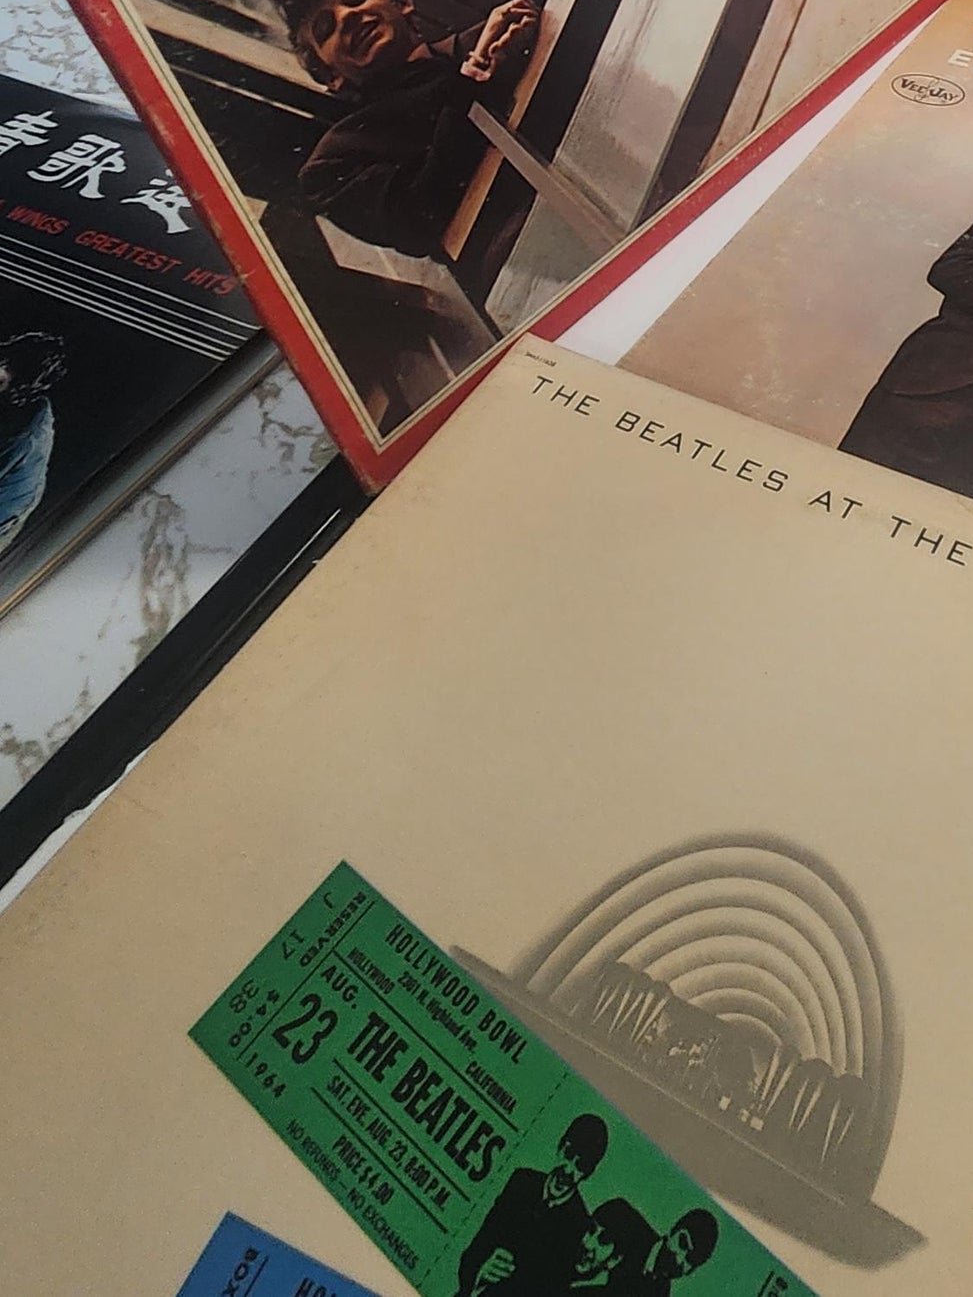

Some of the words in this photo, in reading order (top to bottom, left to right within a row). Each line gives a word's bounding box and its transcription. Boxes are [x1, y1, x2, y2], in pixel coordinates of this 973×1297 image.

[7, 205, 70, 235] WINGS
[75, 229, 183, 274] GREATEST
[183, 267, 240, 296] HITS
[530, 375, 600, 417] THE
[614, 410, 789, 493] BEATLES
[808, 489, 863, 520] AT
[890, 515, 973, 567] THE
[300, 891, 366, 968] RESERVED
[321, 965, 360, 1009] AUG.
[385, 924, 480, 1017] HOLLYWOOD
[477, 1008, 527, 1064] BOWL
[272, 993, 338, 1064] 23
[347, 947, 396, 995] HOLLYWOOD
[465, 1060, 517, 1115] CALIFORNIA
[246, 1053, 287, 1098] 1964
[347, 1011, 410, 1084] THE
[390, 1056, 506, 1183] BEATLES
[286, 1119, 306, 1141] NO
[332, 1135, 368, 1175] PRICE
